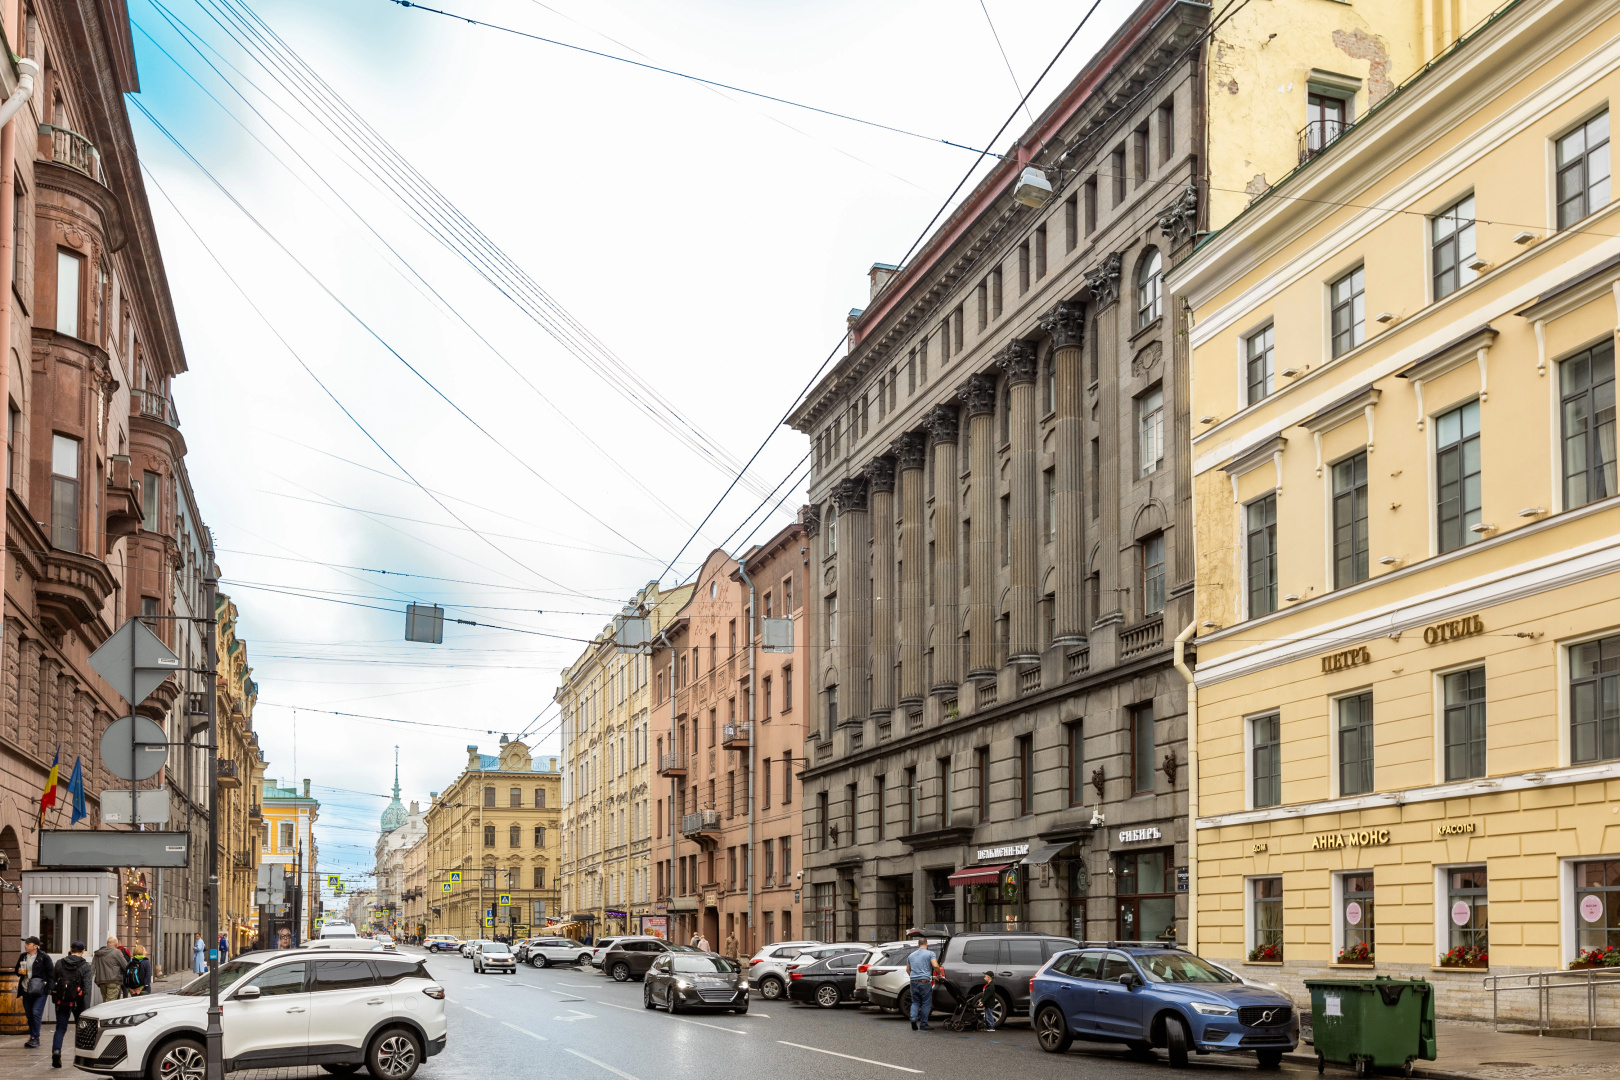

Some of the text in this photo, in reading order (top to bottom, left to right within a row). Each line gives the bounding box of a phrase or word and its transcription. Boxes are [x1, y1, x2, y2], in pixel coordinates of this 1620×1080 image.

[1423, 614, 1484, 645] ОТЕЛЬ
[1320, 645, 1371, 673] ПЕТРЪ
[977, 844, 1029, 860] ПЕЛЬМЕНИ-БАР
[1252, 823, 1475, 853] ДОМ АННА МОНС КРАСОТЫ
